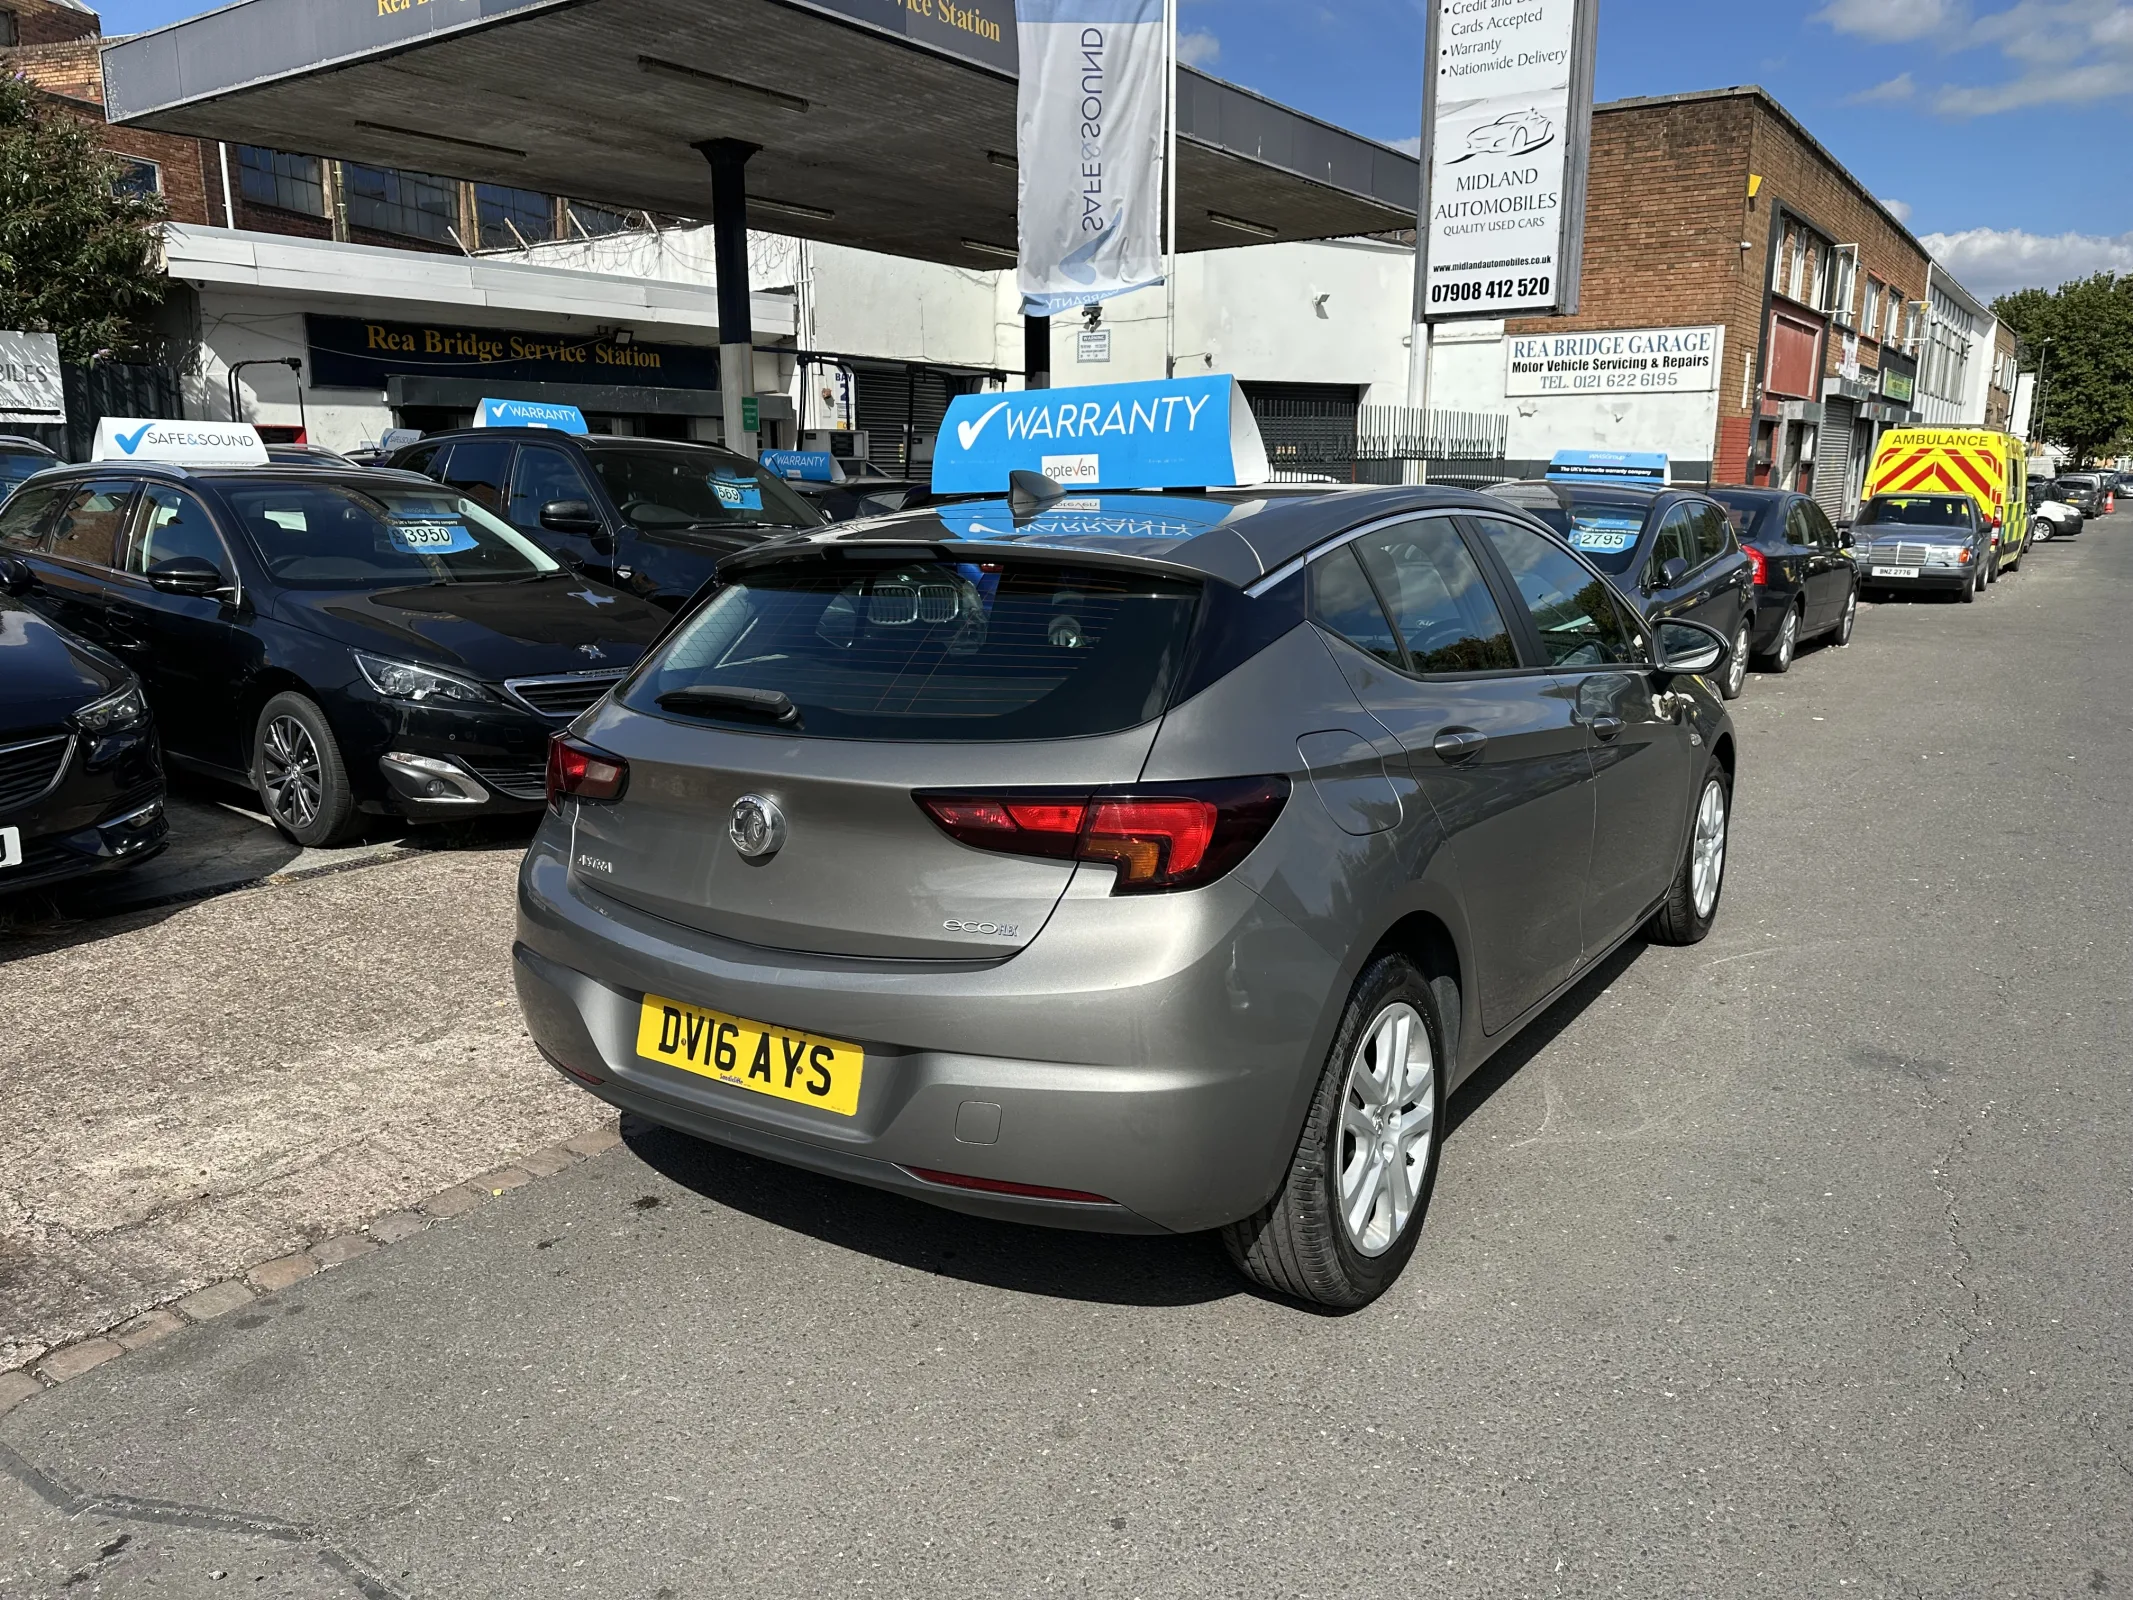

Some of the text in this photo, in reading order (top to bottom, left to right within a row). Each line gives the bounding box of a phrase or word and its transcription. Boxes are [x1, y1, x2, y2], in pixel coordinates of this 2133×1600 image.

[1452, 0, 1487, 15] Credit
[938, 0, 1000, 42] Station
[1451, 8, 1543, 36] Cards Accepted
[1450, 39, 1502, 57] Warranty
[1449, 49, 1567, 77] Nationwide Delivery
[1456, 168, 1538, 192] MIDLAND
[1435, 192, 1557, 220] AUTOMOBILES
[1443, 217, 1545, 236] QUALITY USED CARS
[1433, 255, 1551, 272] www.midlandautomobiles.co.uk
[1431, 276, 1550, 303] 07908 412 520
[365, 325, 661, 368] Rea Bridge Service Station
[1514, 332, 1711, 358] REA BRIDGE GARAGE
[1512, 355, 1709, 373] Motor Vehicle Servicing & Repairs
[1541, 372, 1678, 389] TEL. 0121 622 6195
[508, 405, 576, 422] WARRANTY
[1006, 394, 1210, 440] WARRANTY
[147, 432, 254, 447] SAFE&SOUND
[1892, 434, 1988, 446] AMBULANCE
[777, 455, 825, 467] WARRANTY
[1045, 458, 1096, 480] opteven
[658, 1005, 835, 1097] DV16 AYS
